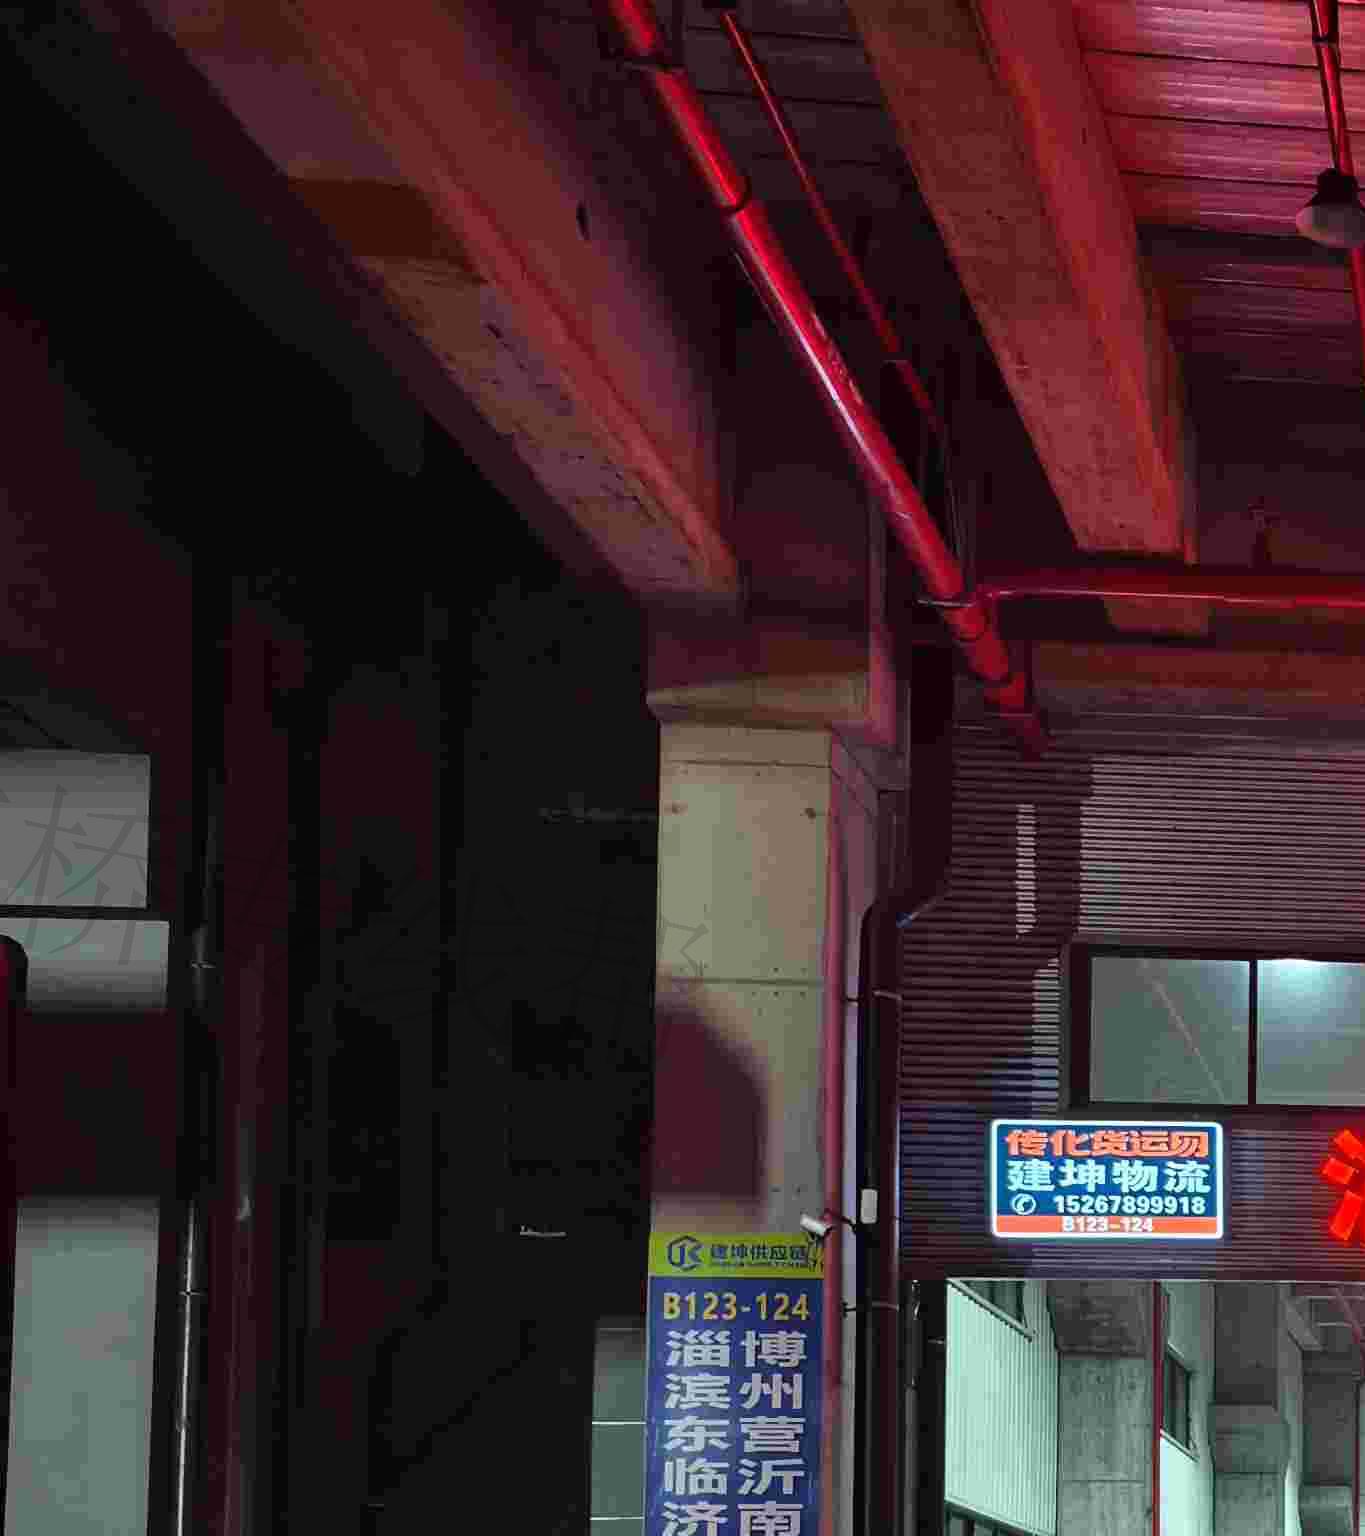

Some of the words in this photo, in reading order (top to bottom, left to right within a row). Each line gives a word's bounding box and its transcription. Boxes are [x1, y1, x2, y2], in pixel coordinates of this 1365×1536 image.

[1007, 1159, 1211, 1193] 建坤物流
[1053, 1195, 1206, 1215] 15267899918
[1062, 1217, 1153, 1233] B123-124
[664, 1291, 810, 1321] B123-124
[666, 1330, 807, 1368] 淄博
[664, 1373, 804, 1411] 滨州
[663, 1415, 805, 1453] 东营
[663, 1458, 805, 1496] 临沂
